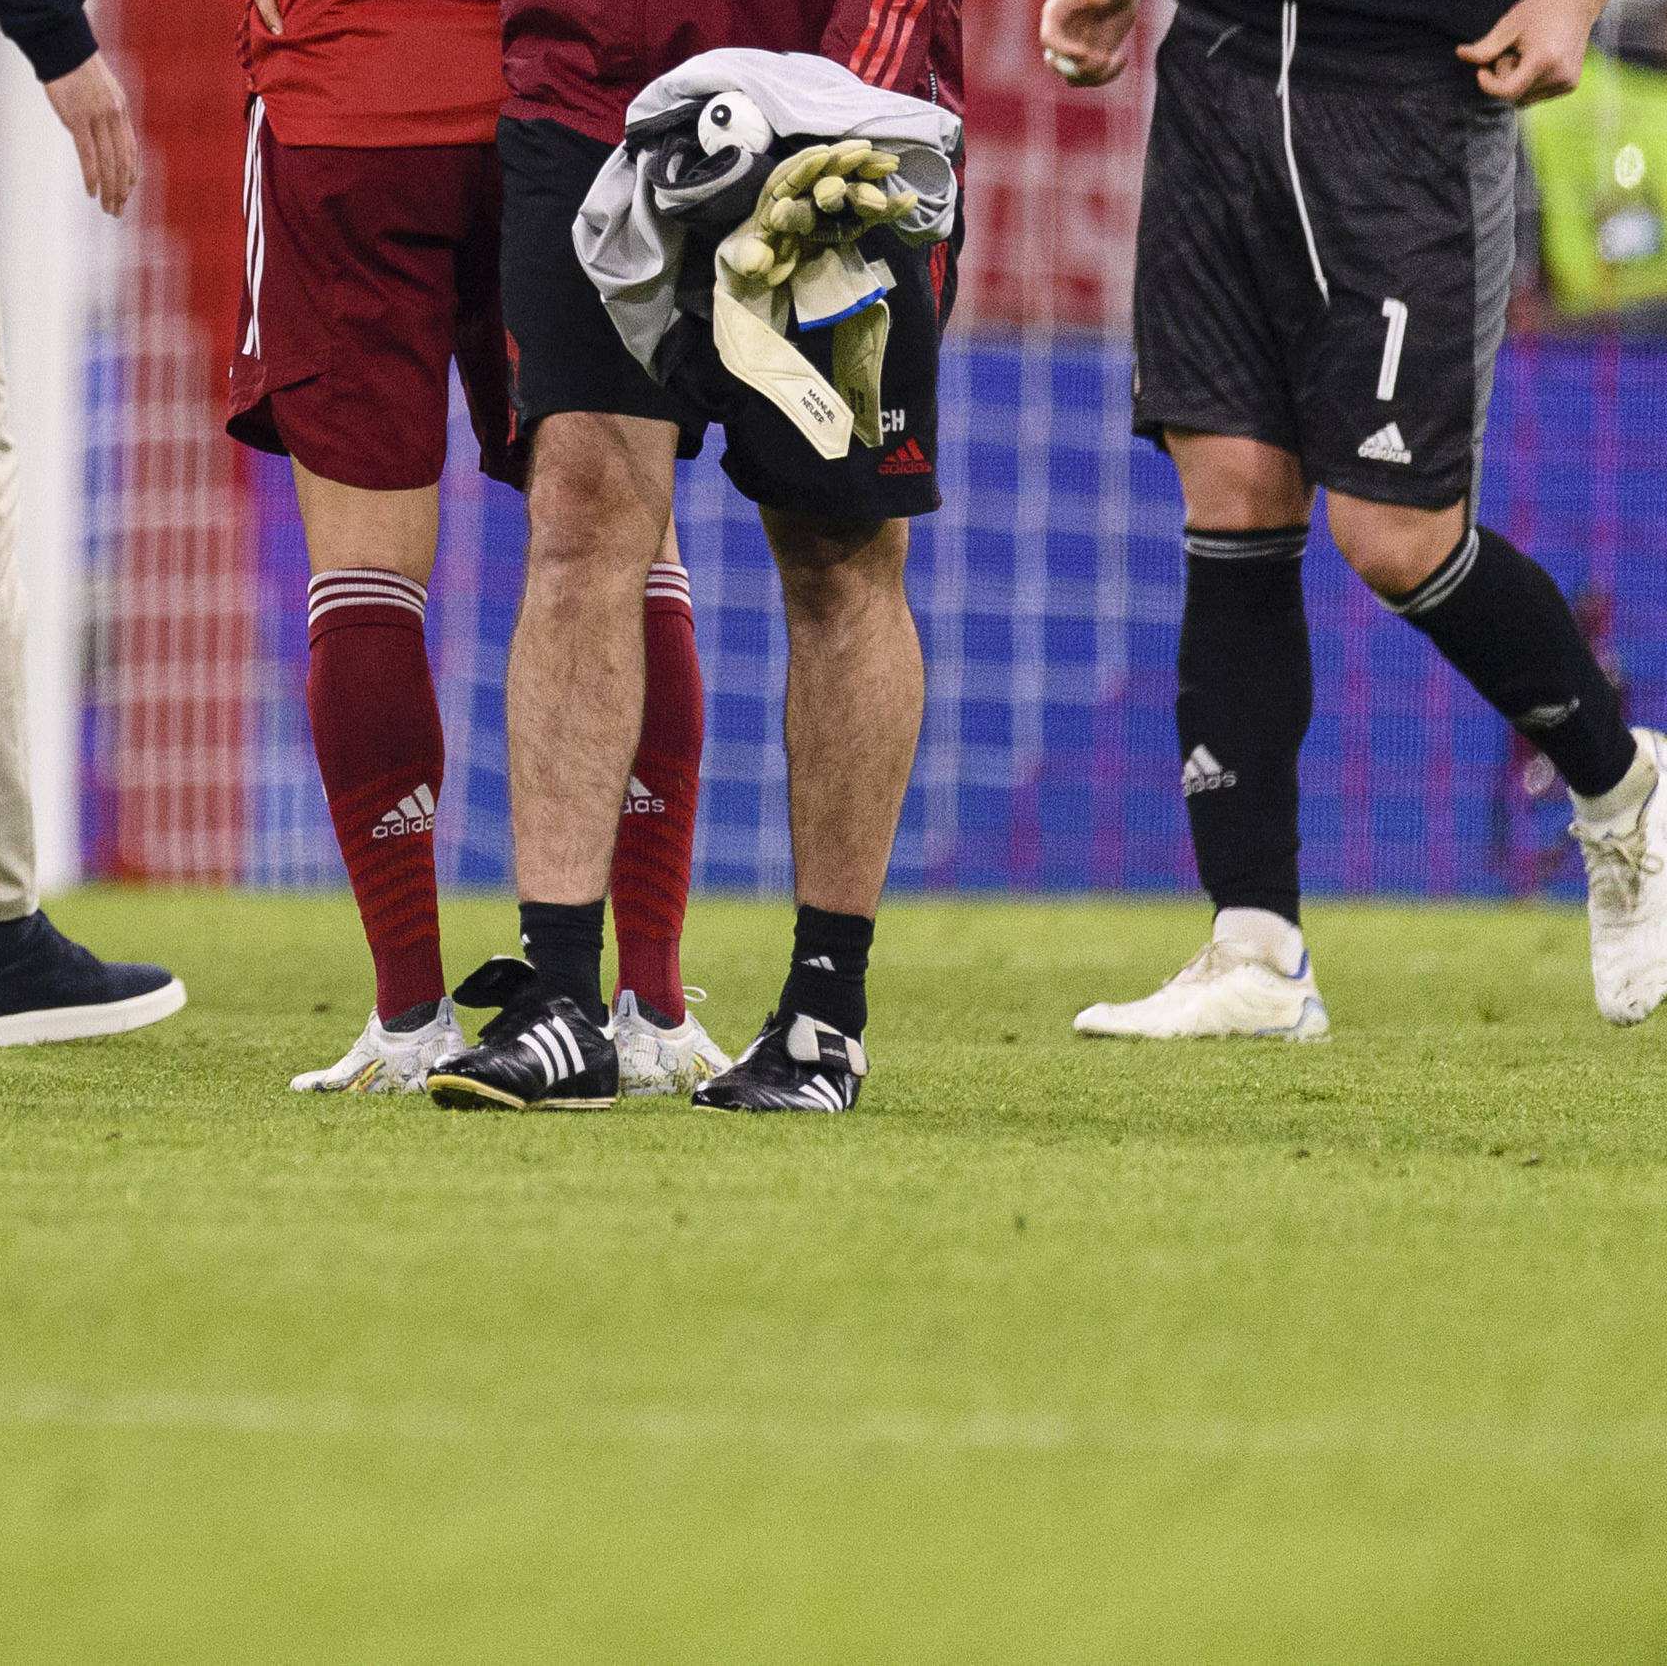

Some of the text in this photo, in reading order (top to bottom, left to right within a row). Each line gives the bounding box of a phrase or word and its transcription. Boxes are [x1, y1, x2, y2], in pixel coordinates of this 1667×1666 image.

[1376, 297, 1409, 401] 1
[800, 396, 825, 425] NEUER
[807, 389, 836, 424] MANUEL
[878, 459, 932, 475] adidas
[372, 812, 435, 839] adida
